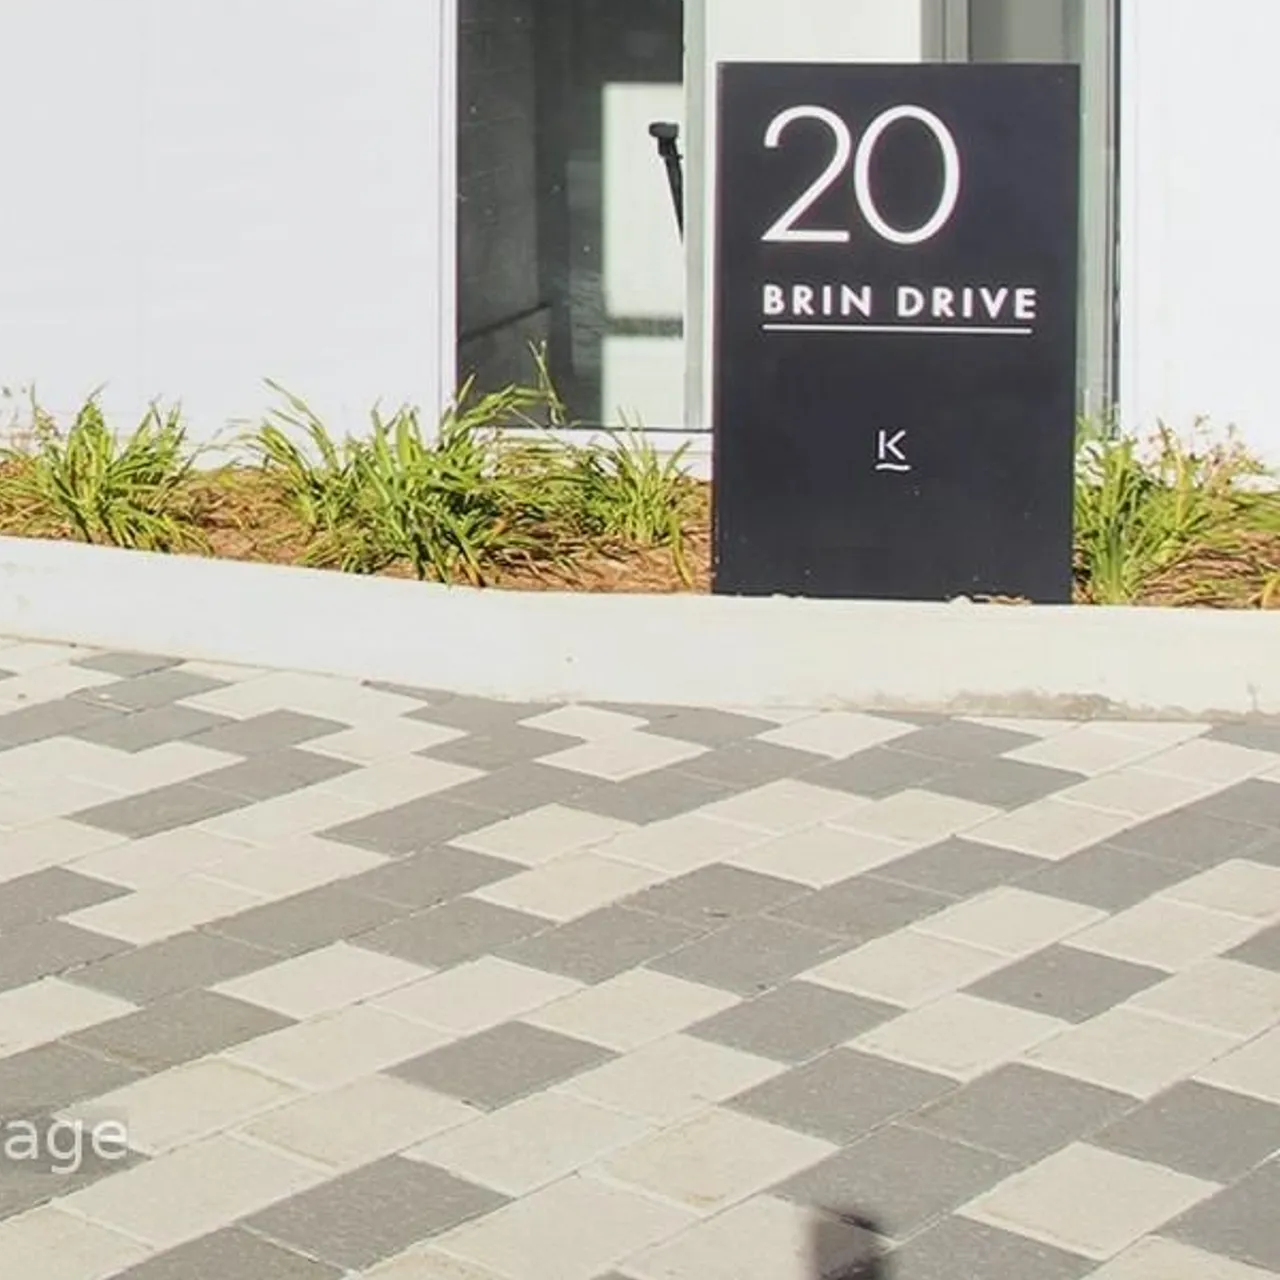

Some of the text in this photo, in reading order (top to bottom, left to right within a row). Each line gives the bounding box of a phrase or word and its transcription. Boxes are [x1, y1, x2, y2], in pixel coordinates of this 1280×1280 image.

[760, 104, 961, 246] 20
[762, 283, 1038, 321] BRIN DRIVE
[877, 429, 908, 462] K
